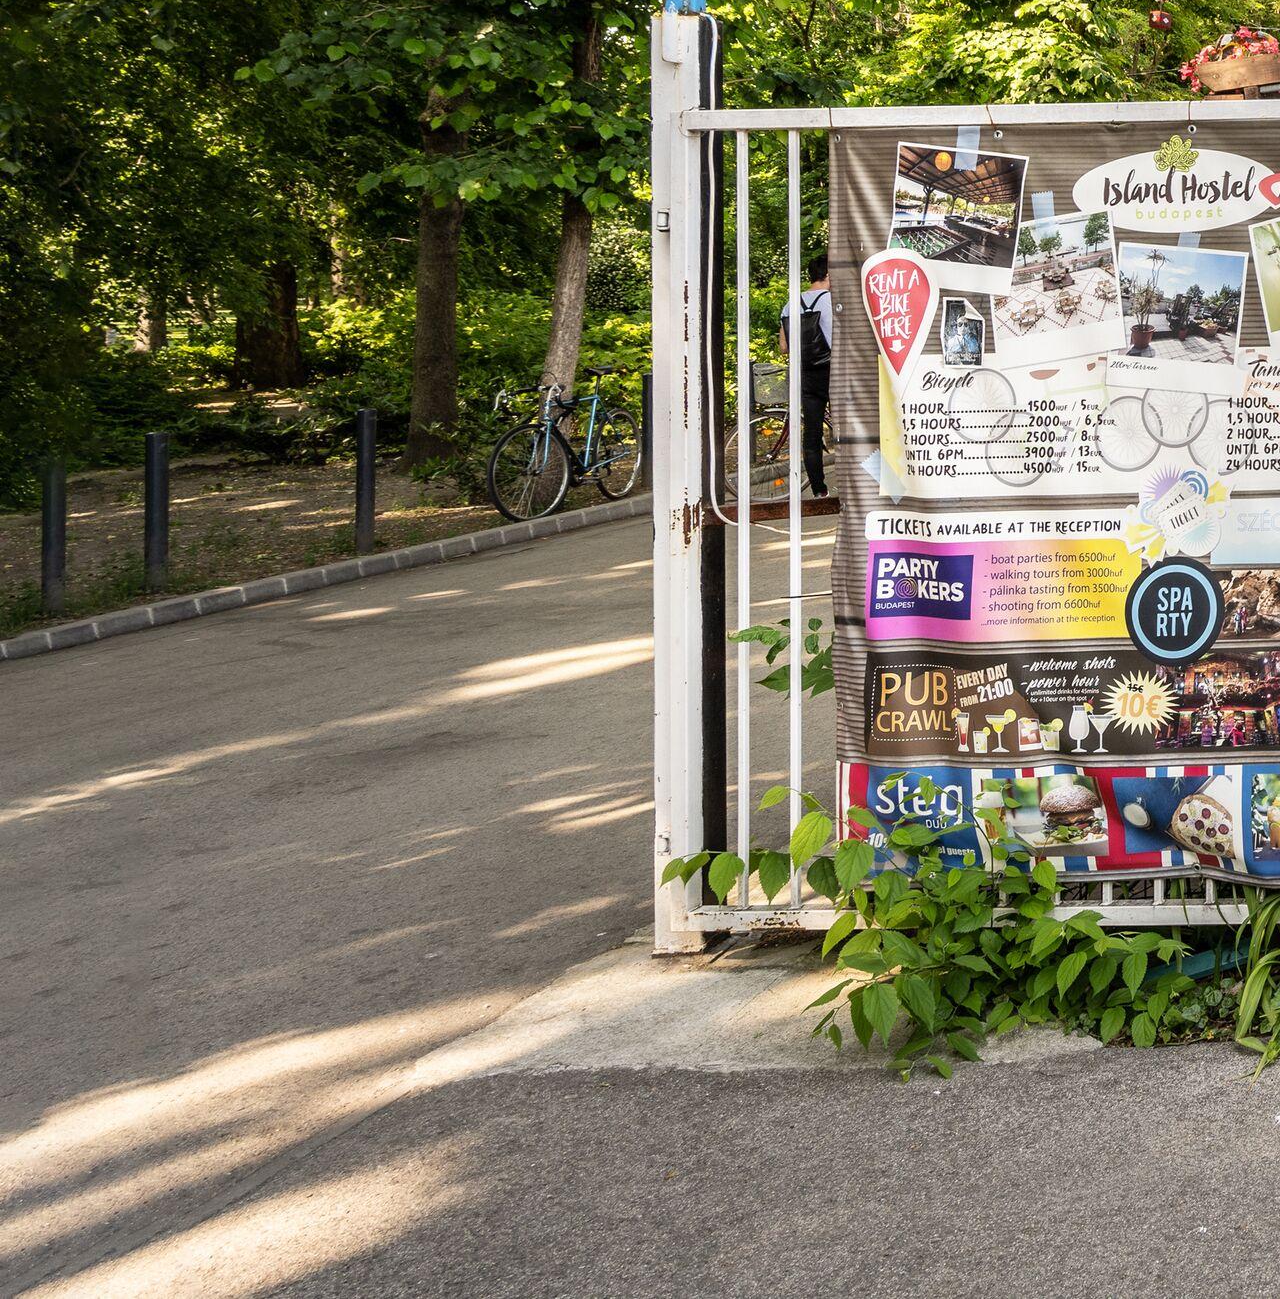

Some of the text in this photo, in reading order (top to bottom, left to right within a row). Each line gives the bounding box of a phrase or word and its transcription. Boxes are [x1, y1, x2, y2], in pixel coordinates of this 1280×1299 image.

[1103, 166, 1256, 205] Island Hostel
[1135, 206, 1223, 221] budapest
[869, 269, 919, 297] RENT A
[874, 293, 910, 320] BIKE
[881, 315, 912, 339] HERE
[922, 371, 974, 393] Bicycle
[906, 450, 932, 460] UNTIL
[1227, 444, 1259, 455] UNTIL
[1227, 460, 1240, 470] 24
[878, 518, 1121, 537] TICKETS AVAILABLE AT THE RECEPTION
[1171, 507, 1199, 529] TICKET
[878, 557, 938, 578] PARTY
[991, 552, 1116, 565] boat parties from 6500huf
[991, 568, 1122, 581] walking tours from 3000huf
[989, 583, 1128, 598] pálinka tasting from 3500huf
[1158, 587, 1192, 611] SPA
[875, 601, 915, 610] BUDAPEST
[988, 599, 1100, 613] shooting from 6600huf
[1010, 616, 1054, 624] information
[1157, 612, 1192, 636] RTY
[1083, 656, 1116, 670] shots
[956, 663, 1008, 690] EVERY DAY
[1071, 675, 1100, 687] hour
[879, 671, 949, 707] PUB
[960, 678, 1014, 708] FROM 21:00
[1117, 693, 1160, 718] 10€
[876, 709, 951, 733] CRAWL
